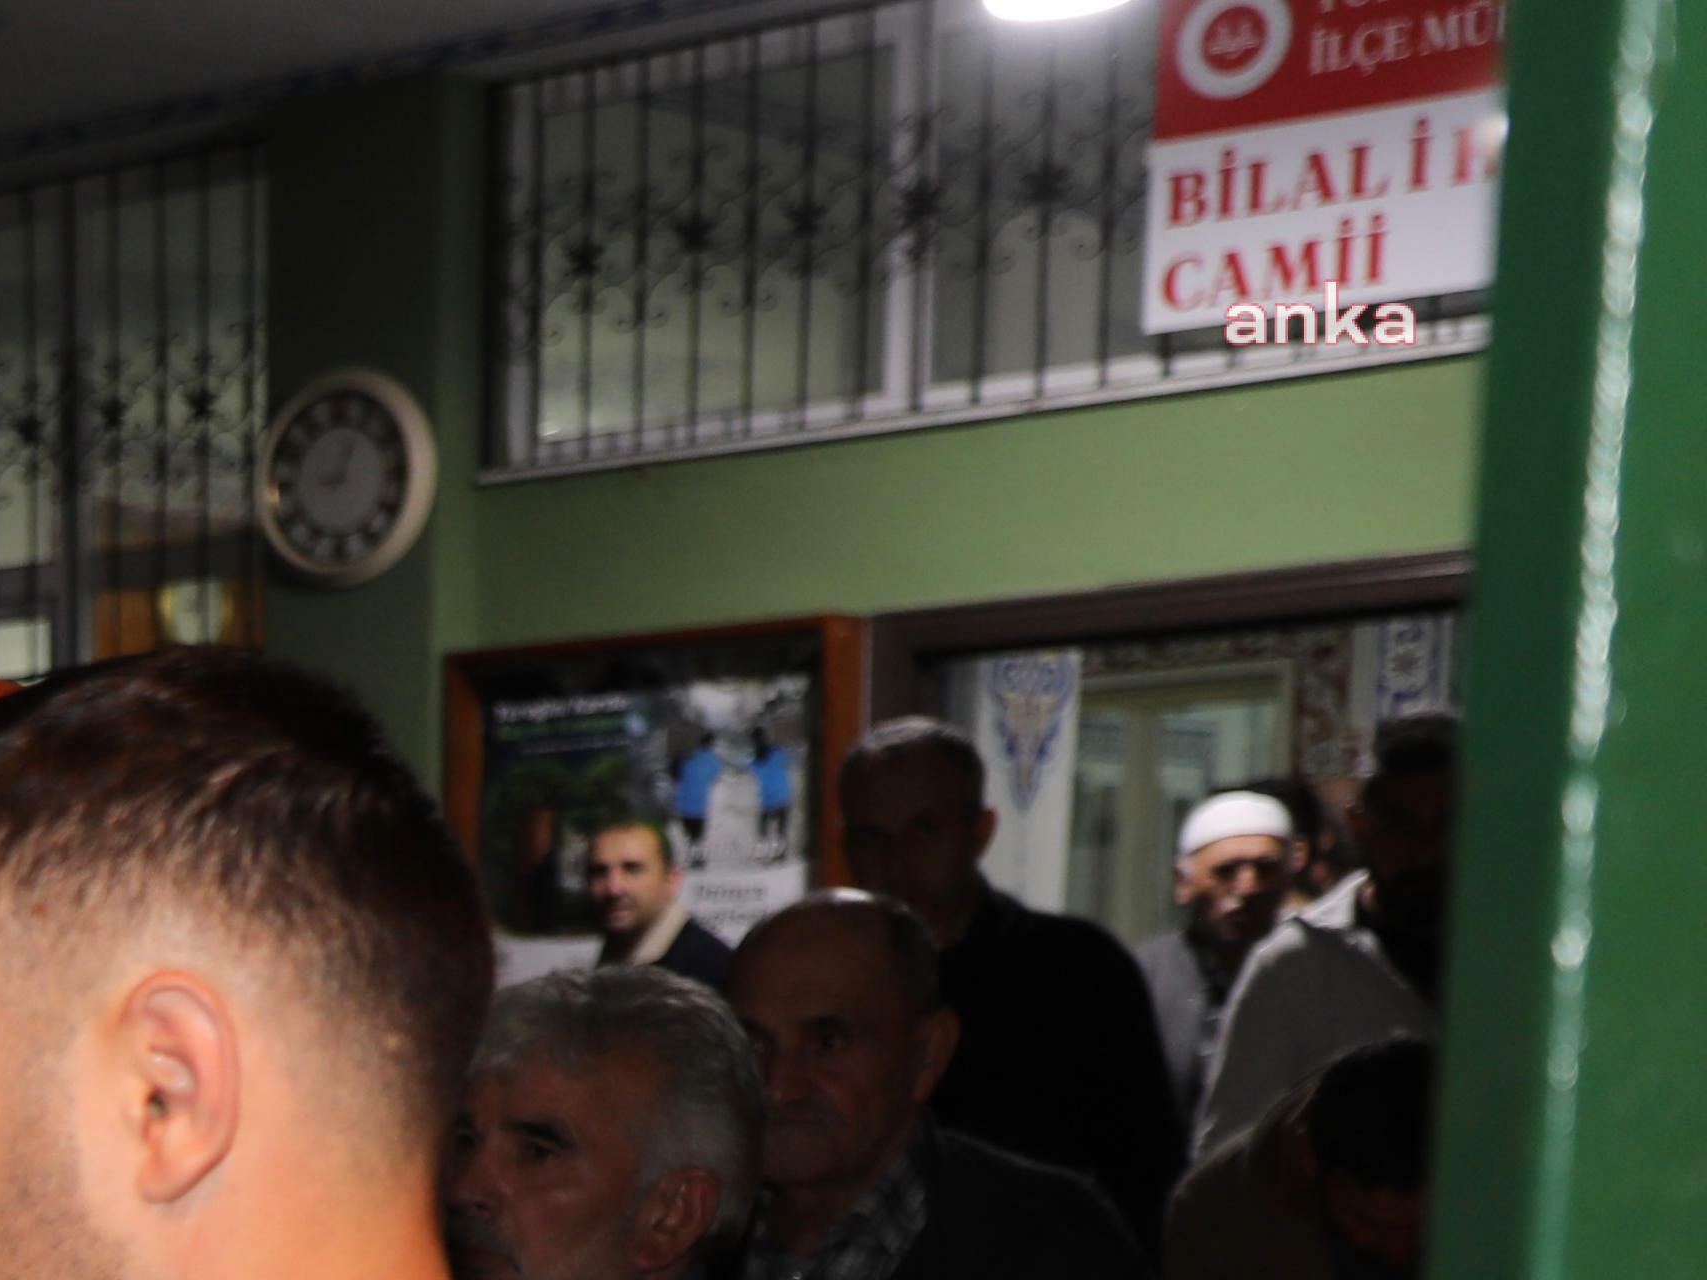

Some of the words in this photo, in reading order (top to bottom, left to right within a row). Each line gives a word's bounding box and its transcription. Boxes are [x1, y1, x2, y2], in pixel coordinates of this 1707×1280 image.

[1309, 18, 1412, 76] İLÇE
[1165, 144, 1391, 231] BİLAL
[1161, 211, 1386, 312] CAMİİ
